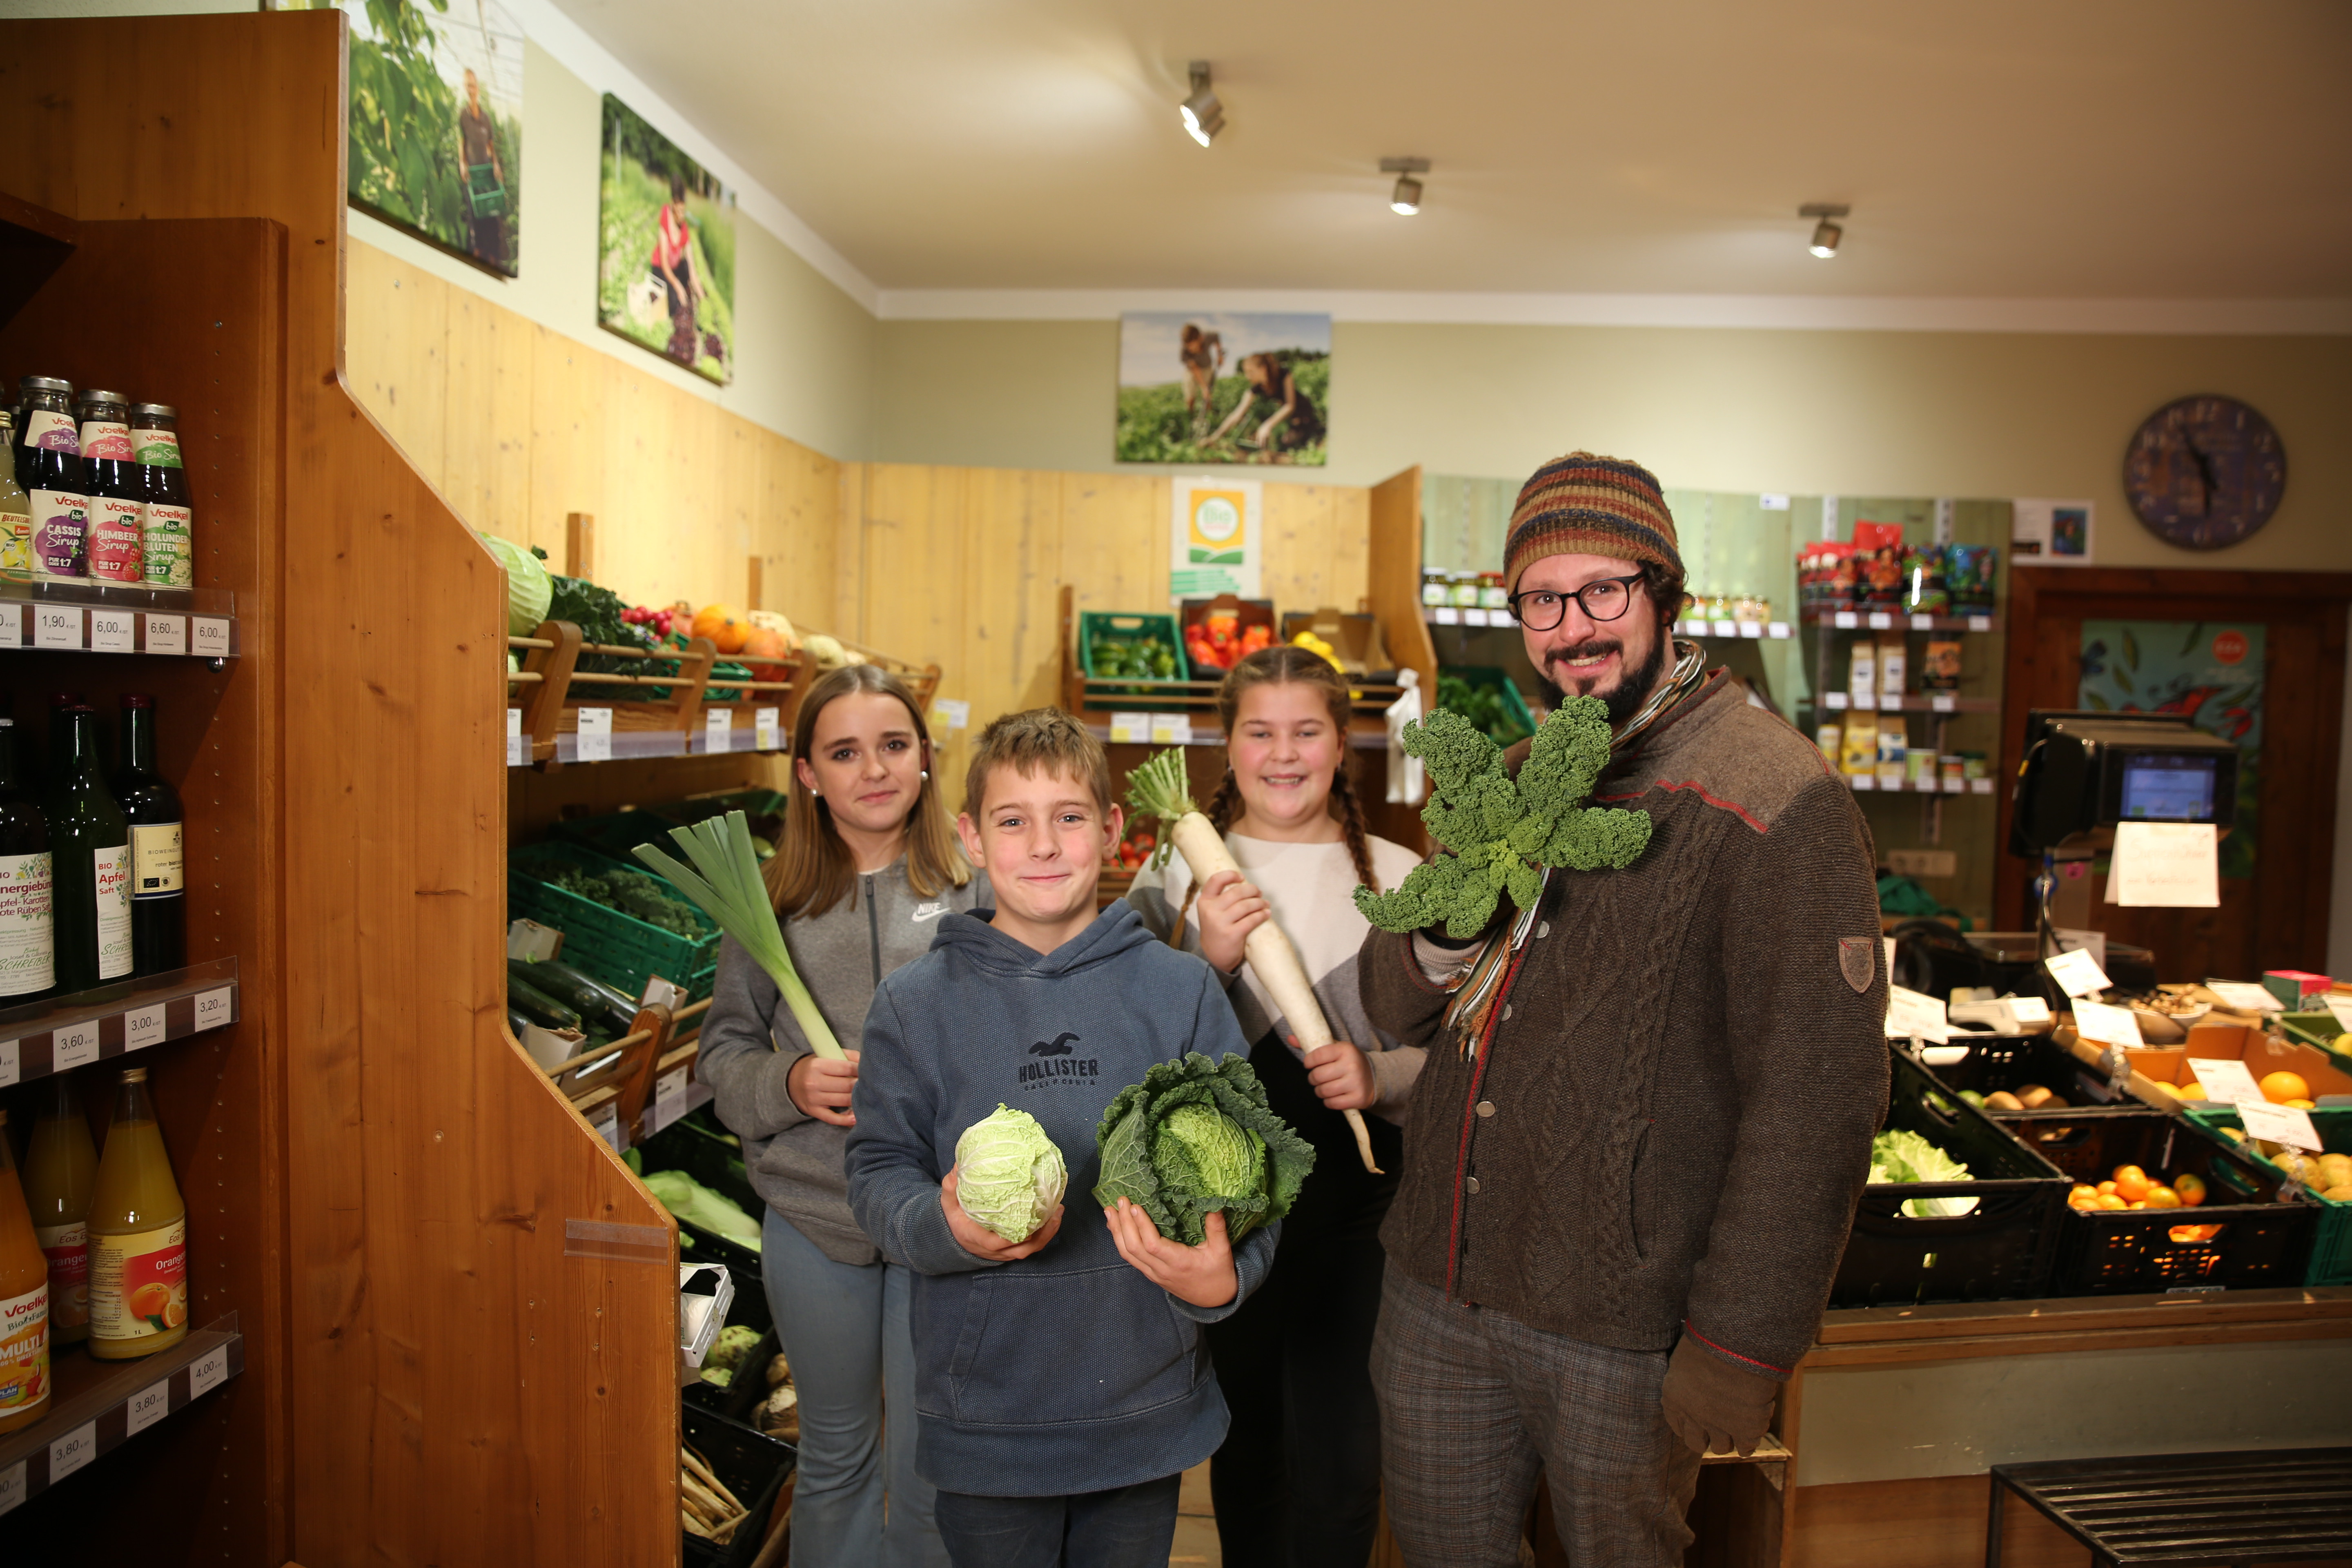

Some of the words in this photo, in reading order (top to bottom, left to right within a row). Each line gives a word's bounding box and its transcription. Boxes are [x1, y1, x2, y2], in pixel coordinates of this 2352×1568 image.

[98, 427, 129, 436] Voelke
[49, 435, 69, 446] Bio
[146, 434, 176, 443] Voelke
[95, 444, 116, 455] Bio
[118, 442, 132, 454] Sir
[143, 450, 161, 461] Bio
[55, 496, 88, 509] Voelke
[71, 511, 82, 520] bio
[150, 509, 188, 520] Voelkel
[121, 517, 133, 526] bio
[166, 522, 177, 530] bio
[47, 524, 81, 537] CASSIS
[97, 530, 138, 542] HIMBEER
[46, 532, 79, 549] Sirup
[96, 538, 129, 554] Sirup
[60, 558, 71, 567] 1:7
[143, 551, 174, 564] Sirup
[109, 562, 120, 570] 1:7
[42, 615, 65, 628] 1,90
[97, 621, 118, 634] 6,00
[151, 623, 170, 635] 6,60
[200, 627, 218, 638] 6,00
[99, 871, 125, 885] Apfel
[0, 880, 52, 895] nergiebünd
[0, 897, 21, 909] pfel-
[918, 902, 941, 913] NIKE
[17, 906, 41, 915] Rüben
[0, 951, 51, 970] SCHREIBER
[200, 999, 218, 1012] 3,20
[132, 1016, 151, 1031] 3,00
[61, 1034, 83, 1050] 3,60
[1020, 1059, 1098, 1082] HOLLISTER
[59, 1235, 78, 1244] Eos
[169, 1234, 180, 1244] Eos
[5, 1293, 48, 1318] Voelke
[7, 1321, 24, 1331] Bio
[0, 1334, 40, 1359] MULTI
[196, 1361, 214, 1378] 4,00
[136, 1394, 156, 1412] 3,80
[56, 1440, 79, 1461] 3,80
